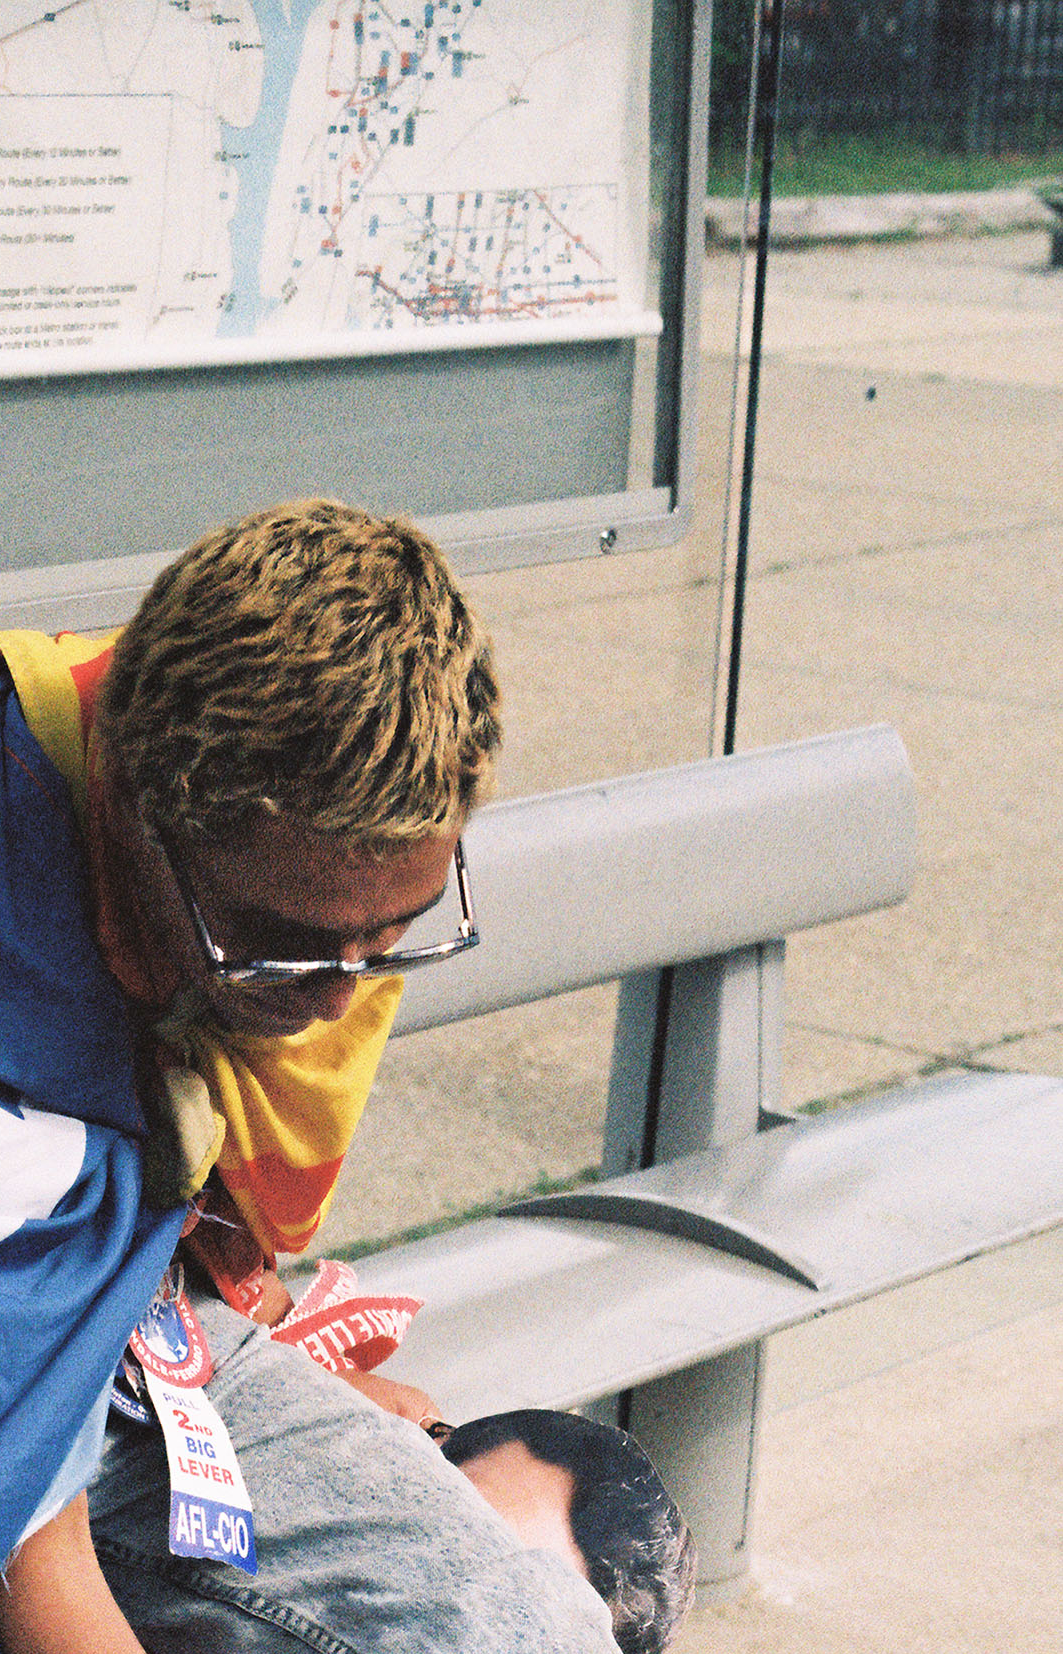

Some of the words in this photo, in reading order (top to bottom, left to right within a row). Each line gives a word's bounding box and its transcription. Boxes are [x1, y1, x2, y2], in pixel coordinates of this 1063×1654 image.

[173, 1409, 213, 1437] 2ND
[184, 1436, 216, 1459] BIG
[177, 1456, 235, 1486] LEVER
[175, 1501, 250, 1559] AFL-CIO
